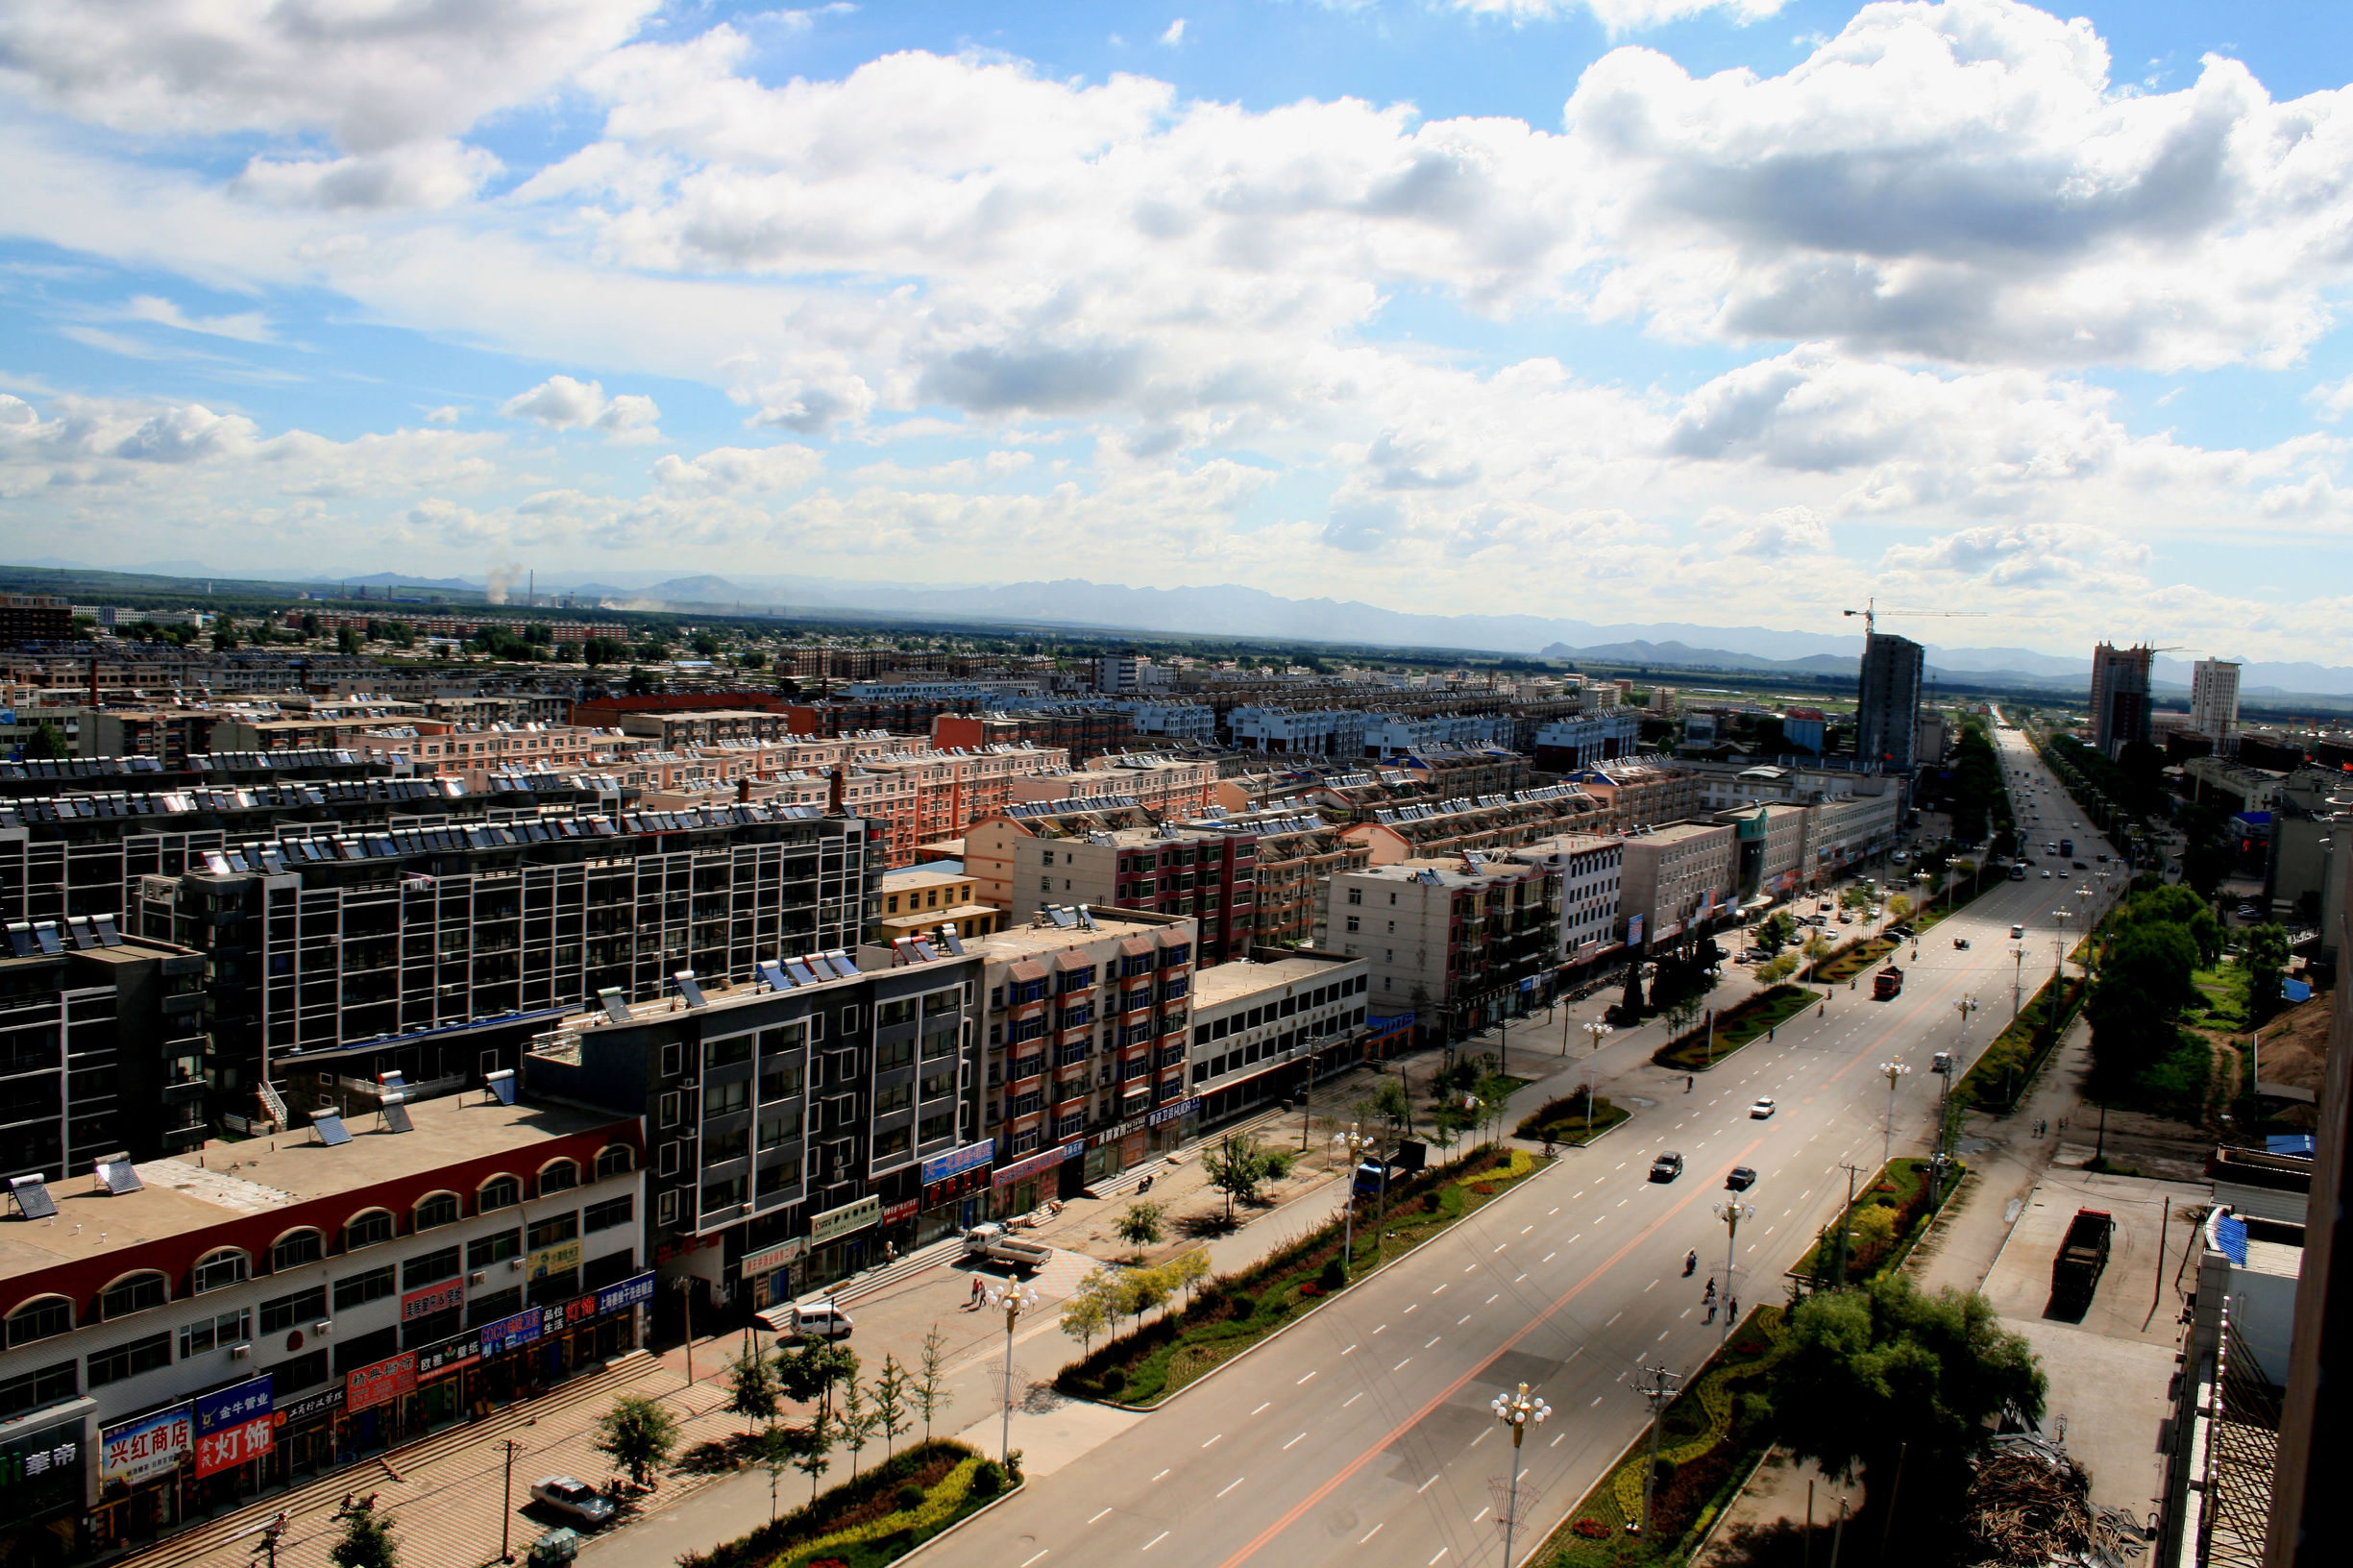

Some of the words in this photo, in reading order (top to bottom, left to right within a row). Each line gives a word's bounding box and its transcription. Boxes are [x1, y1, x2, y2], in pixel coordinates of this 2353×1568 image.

[544, 1306, 564, 1321] 品位
[565, 1295, 597, 1323] 灯饰
[544, 1318, 564, 1335] 生活
[218, 1392, 269, 1420] 金牛管业
[110, 1418, 188, 1469] 兴红商店
[214, 1420, 271, 1465] 灯饰
[25, 1442, 76, 1476] 華帝
